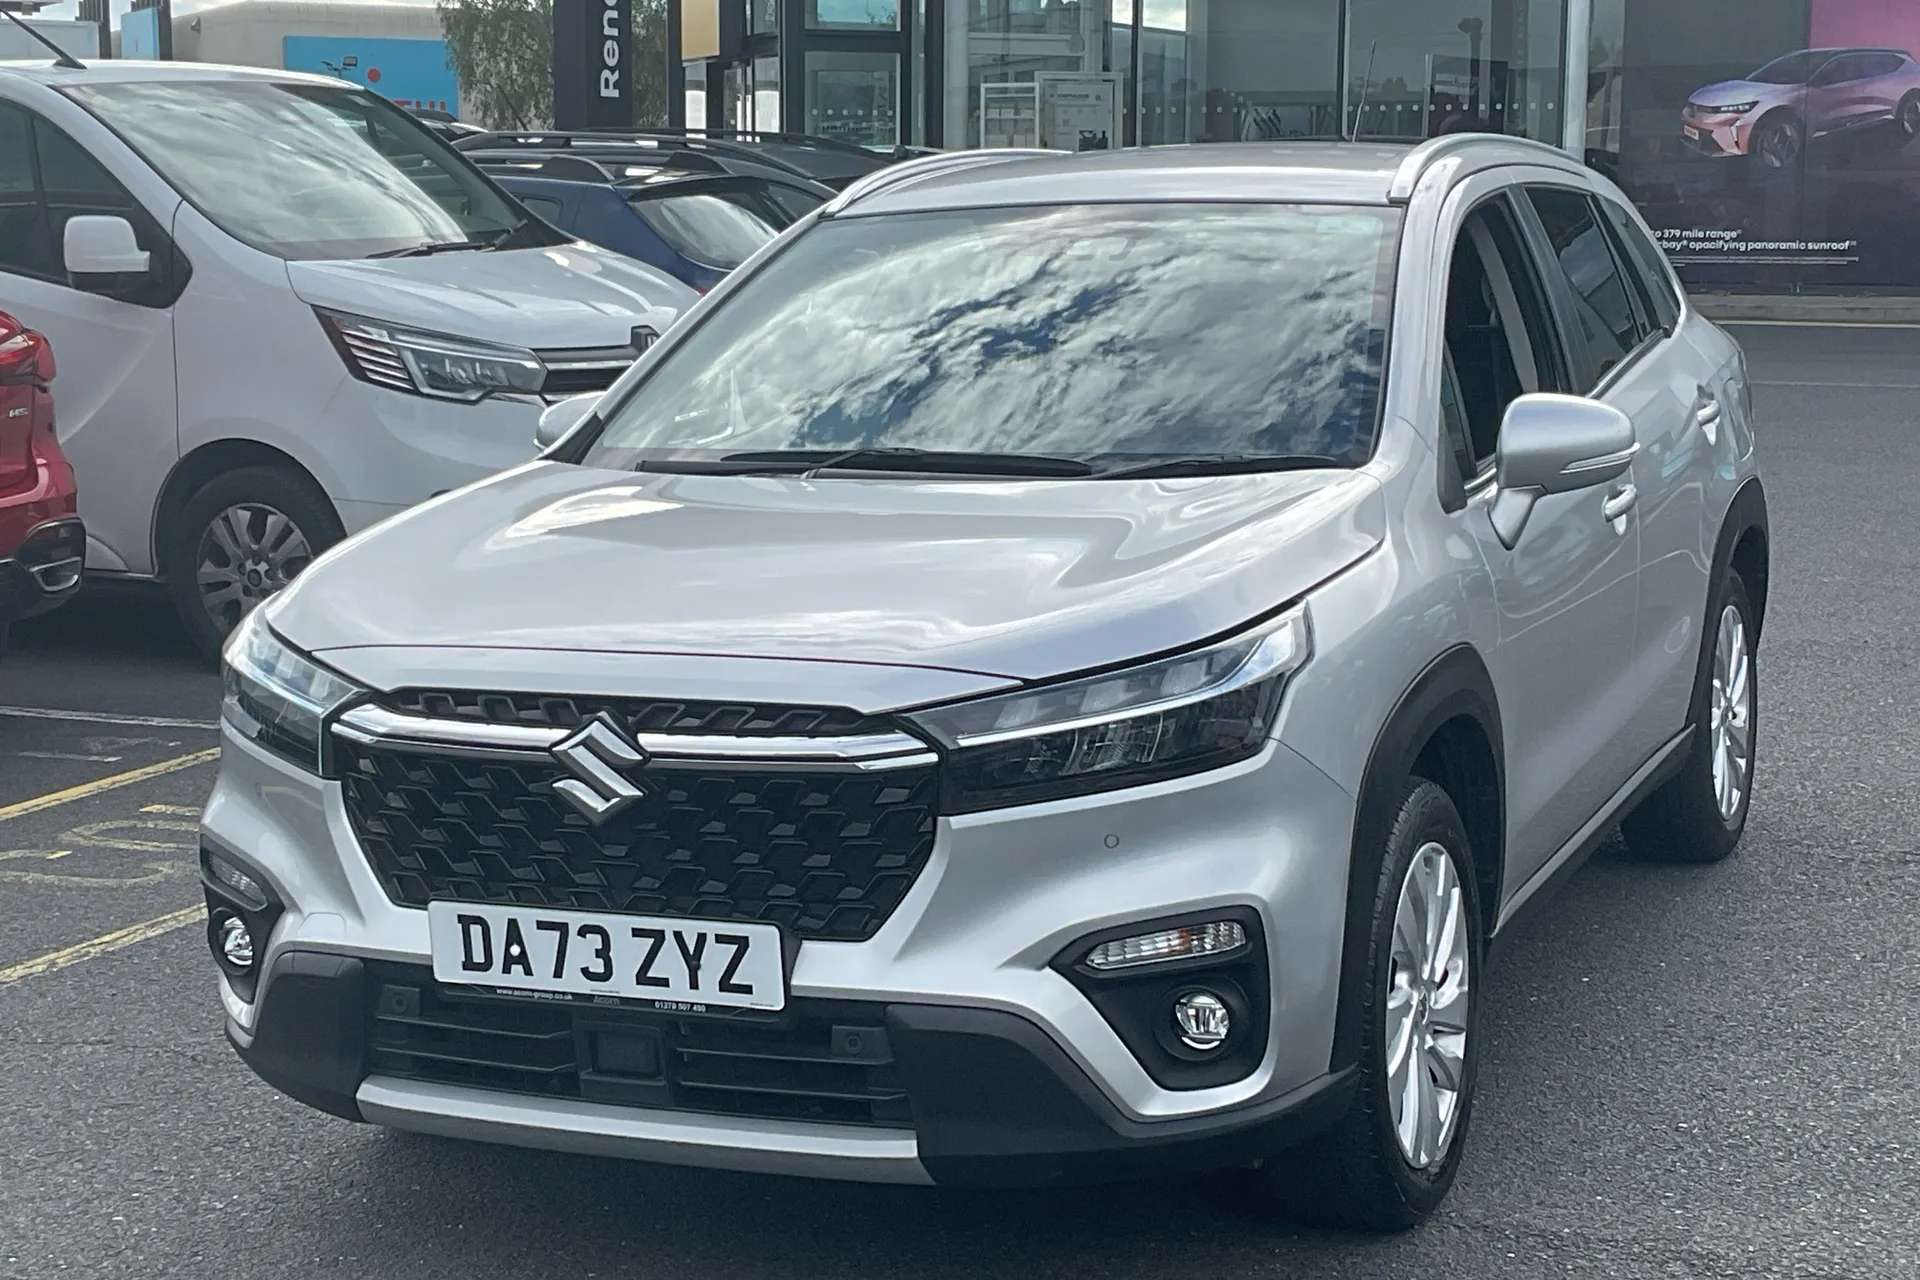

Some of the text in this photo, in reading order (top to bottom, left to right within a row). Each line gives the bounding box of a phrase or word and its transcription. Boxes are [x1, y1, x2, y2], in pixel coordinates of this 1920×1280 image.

[600, 0, 620, 98] Ren
[1663, 229, 1680, 238] 379
[1682, 229, 1705, 238] mile
[1689, 239, 1746, 251] opacifying
[1747, 240, 1806, 251] panoramic
[457, 913, 754, 995] DA73 ZYZ
